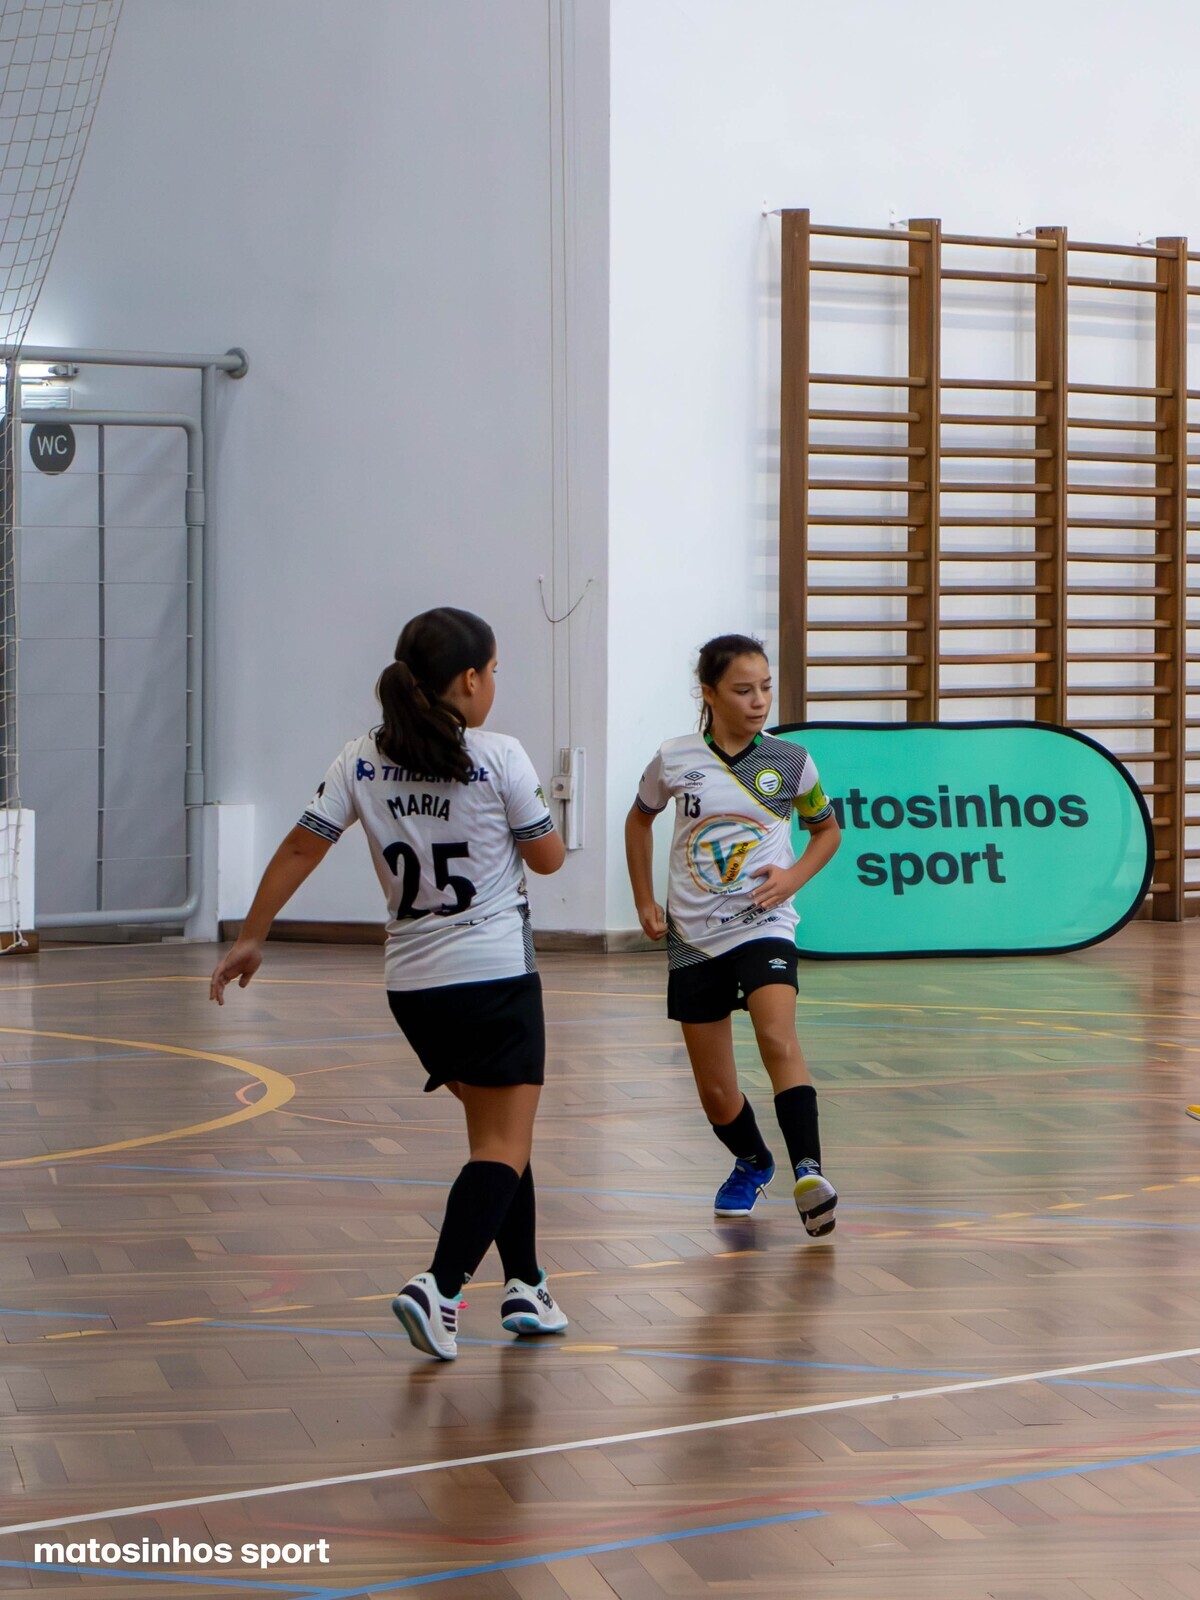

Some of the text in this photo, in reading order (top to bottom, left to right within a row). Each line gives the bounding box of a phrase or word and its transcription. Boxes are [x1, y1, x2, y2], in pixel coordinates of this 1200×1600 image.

[37, 434, 67, 456] WC
[386, 793, 451, 822] MARIA
[683, 792, 702, 819] 13
[798, 784, 1090, 831] tosinhos
[382, 840, 478, 921] 25
[856, 843, 1007, 896] sport
